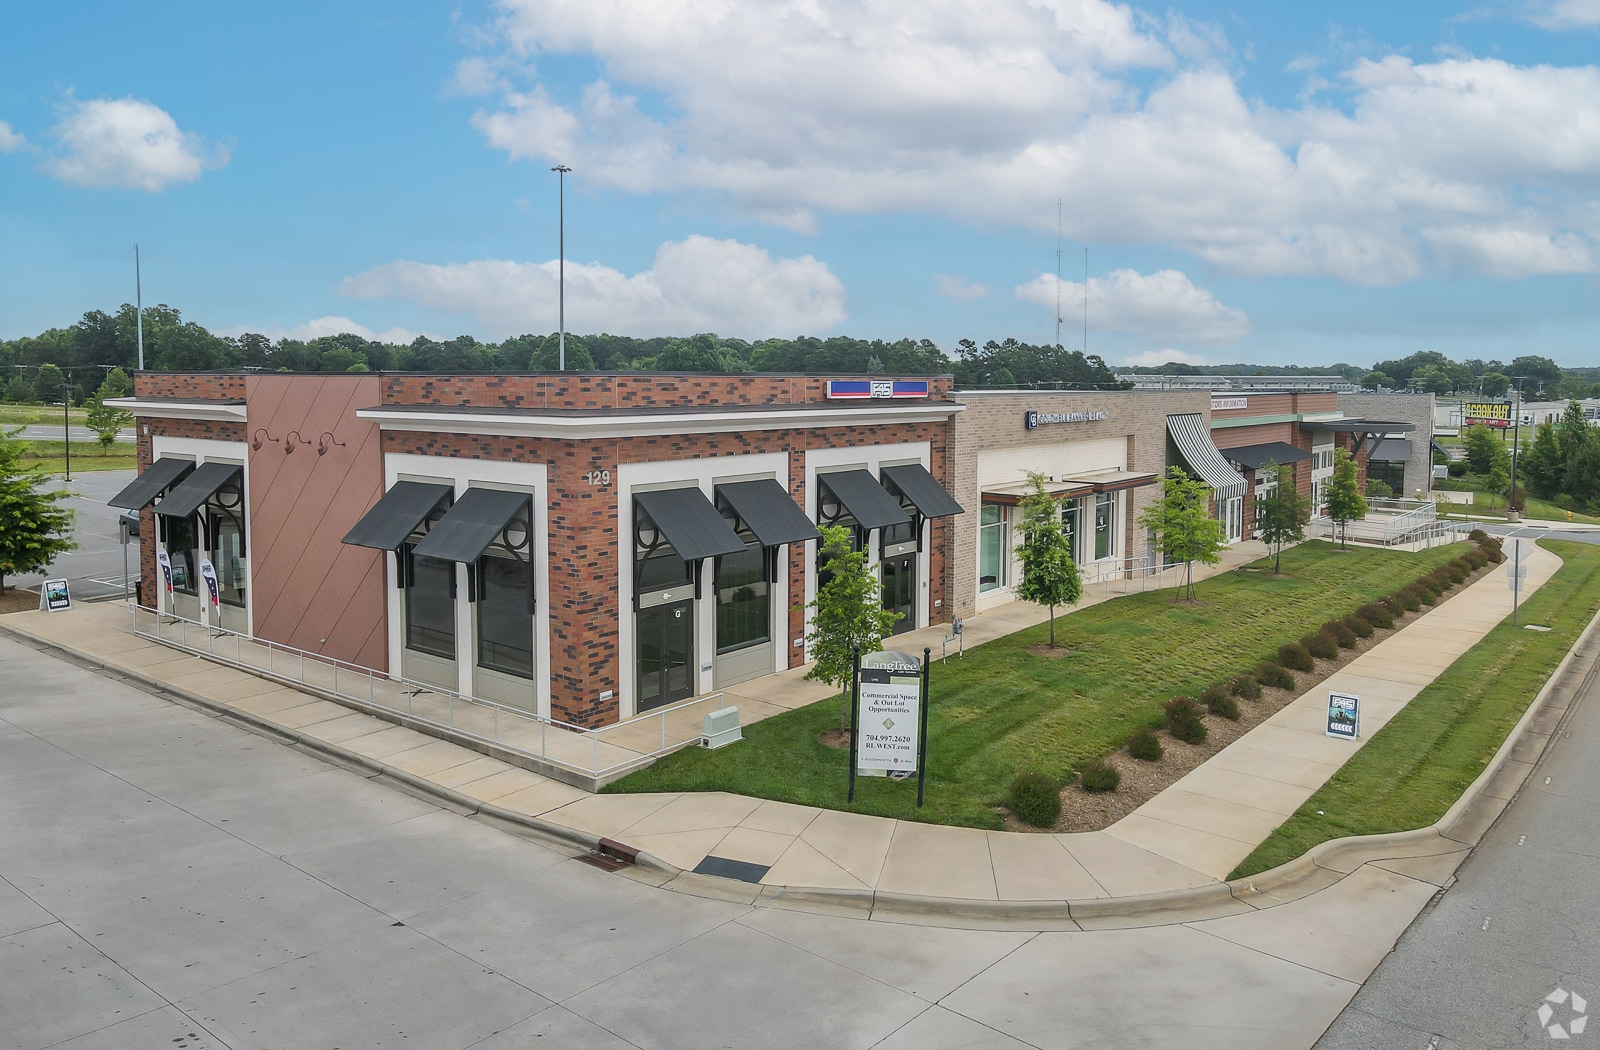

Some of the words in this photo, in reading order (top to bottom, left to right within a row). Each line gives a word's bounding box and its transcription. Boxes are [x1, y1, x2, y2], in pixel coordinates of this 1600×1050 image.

[872, 382, 892, 397] F45
[1471, 404, 1491, 418] COOK
[1493, 404, 1509, 419] OUT
[586, 470, 610, 486] 129
[675, 609, 681, 618] G
[864, 660, 917, 673] LangTree
[862, 691, 899, 700] Commercial
[868, 706, 910, 714] Opportunities
[866, 734, 911, 743] 704.997.2620
